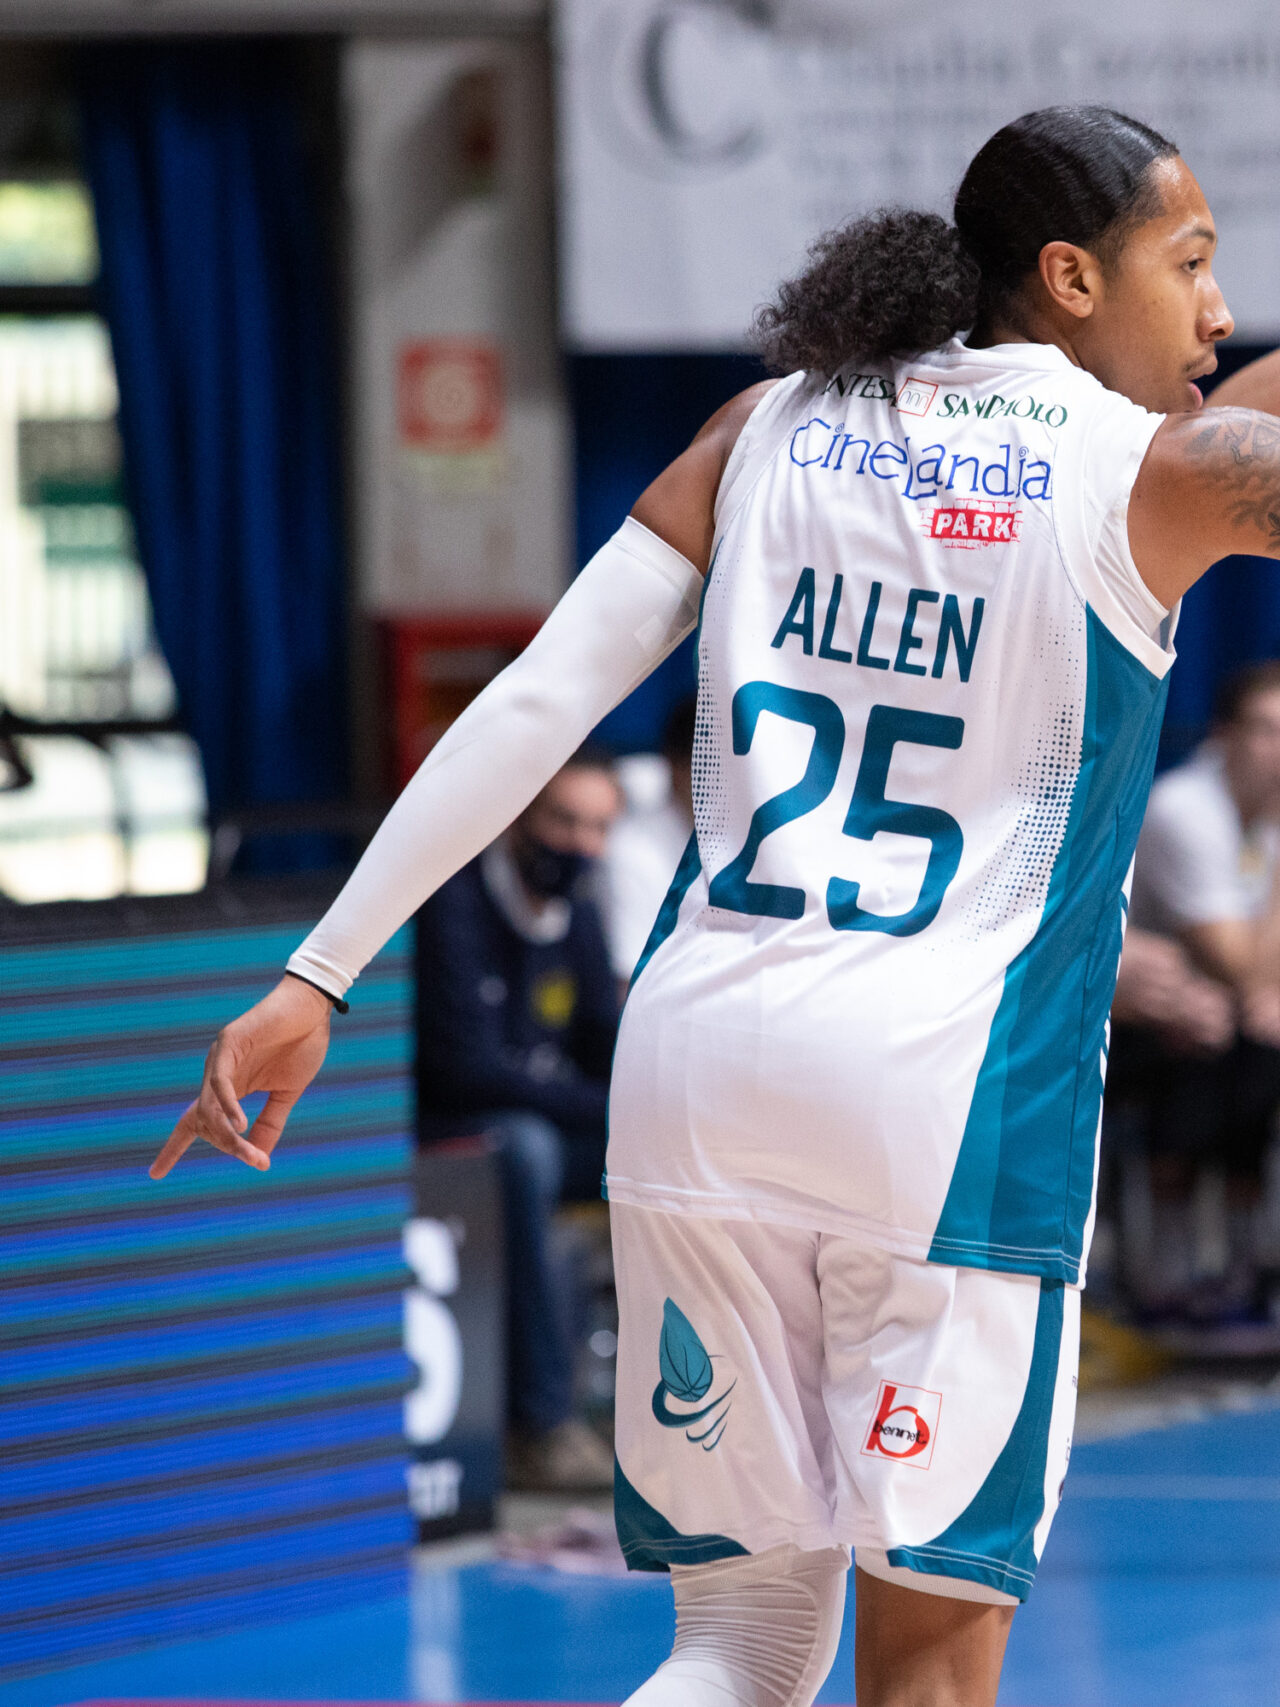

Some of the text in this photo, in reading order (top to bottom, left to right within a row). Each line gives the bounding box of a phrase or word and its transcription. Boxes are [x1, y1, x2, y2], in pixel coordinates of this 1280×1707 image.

[821, 373, 897, 408] NTES
[934, 512, 1015, 541] PARK
[770, 566, 986, 683] ALLEN
[708, 680, 965, 938] 25
[872, 1419, 927, 1445] bennet
